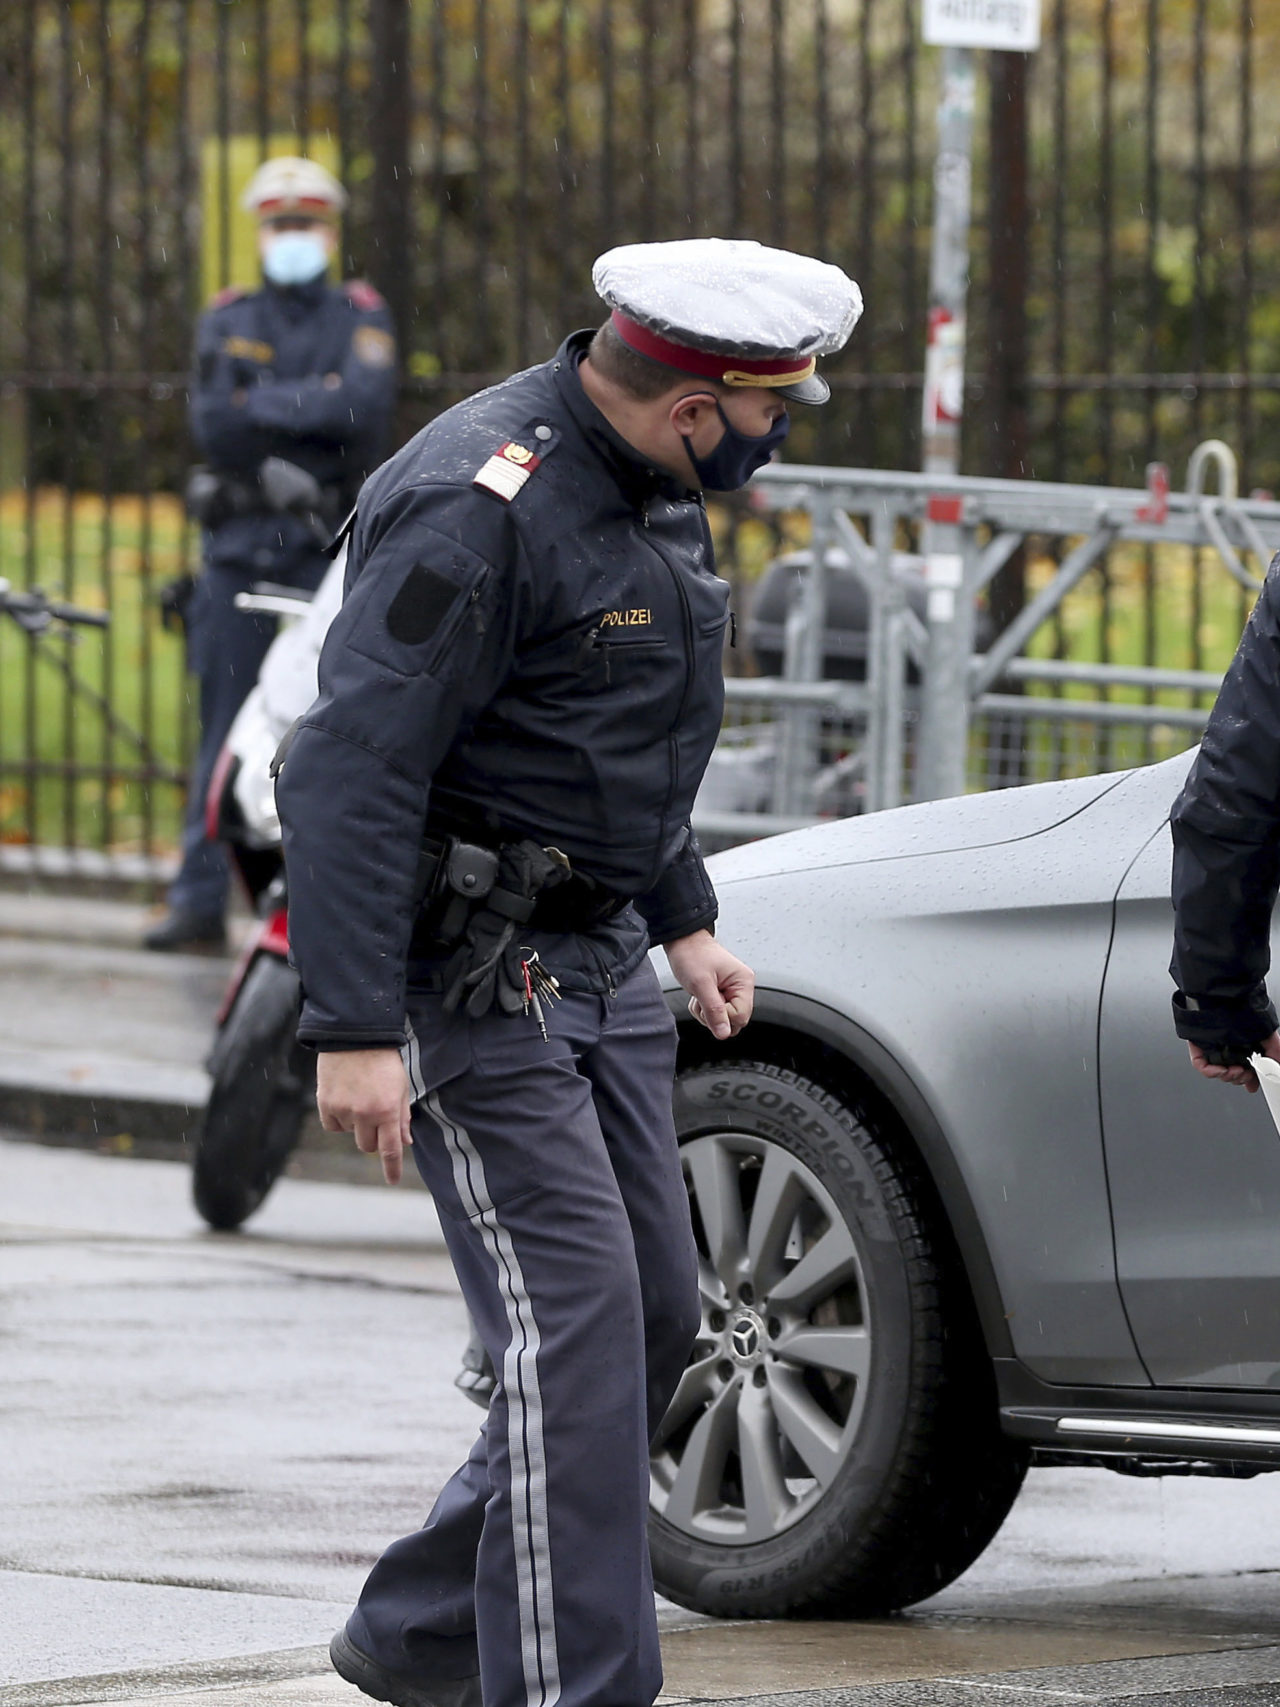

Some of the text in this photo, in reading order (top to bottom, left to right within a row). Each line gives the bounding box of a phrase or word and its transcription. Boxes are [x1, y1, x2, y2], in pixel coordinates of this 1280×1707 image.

[600, 608, 651, 628] POLIZEI
[707, 1081, 876, 1208] SCORPION
[756, 1119, 827, 1177] WINTER
